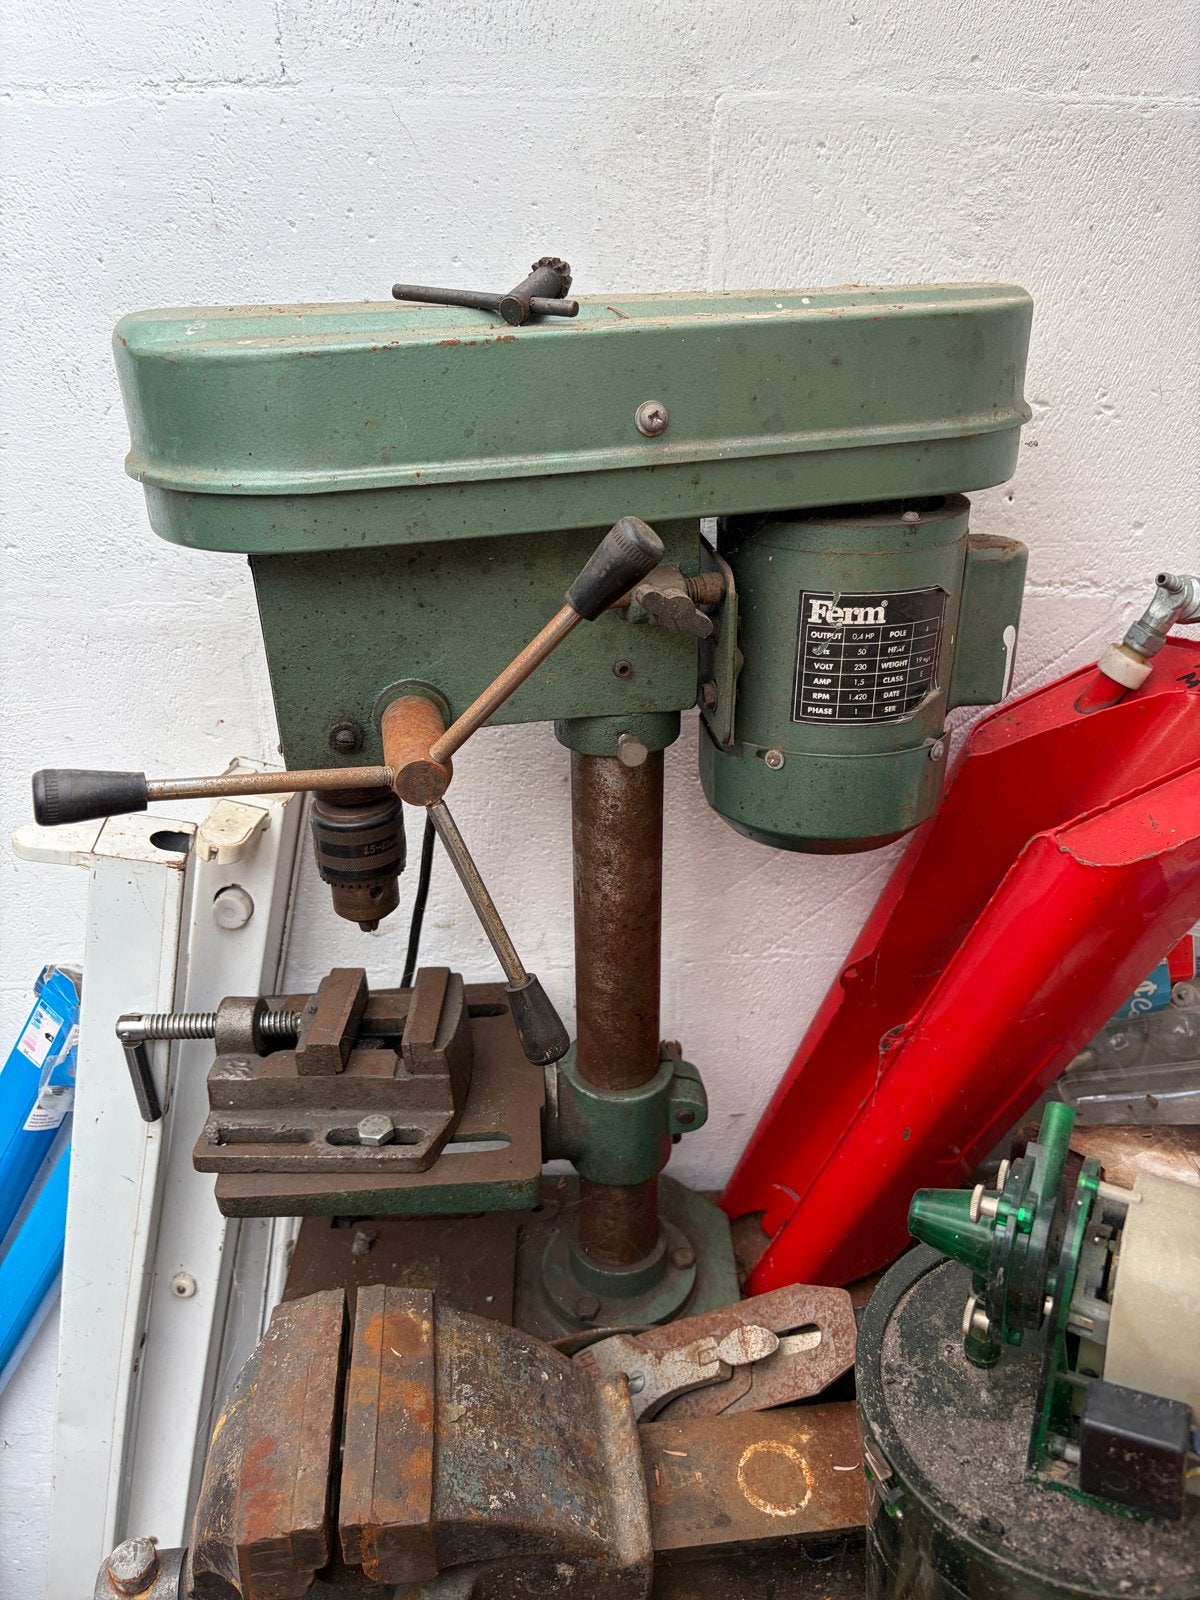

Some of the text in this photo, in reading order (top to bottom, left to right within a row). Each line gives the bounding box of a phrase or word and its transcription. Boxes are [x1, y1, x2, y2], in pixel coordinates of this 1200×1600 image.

[810, 631, 842, 640] OUTPUT
[852, 633, 864, 641] 0,4
[865, 632, 875, 640] HP
[889, 630, 907, 638] POLE
[857, 648, 867, 656] 50
[813, 662, 834, 671] VOLT
[853, 663, 868, 671] 230
[881, 659, 909, 669] WEIGHT
[812, 677, 832, 685] AMP
[854, 678, 865, 687] 1,5
[882, 675, 904, 684] CLASS
[812, 692, 830, 700] RPM
[883, 690, 901, 699] DATE
[807, 706, 833, 715] PHASE
[884, 705, 897, 713] SER
